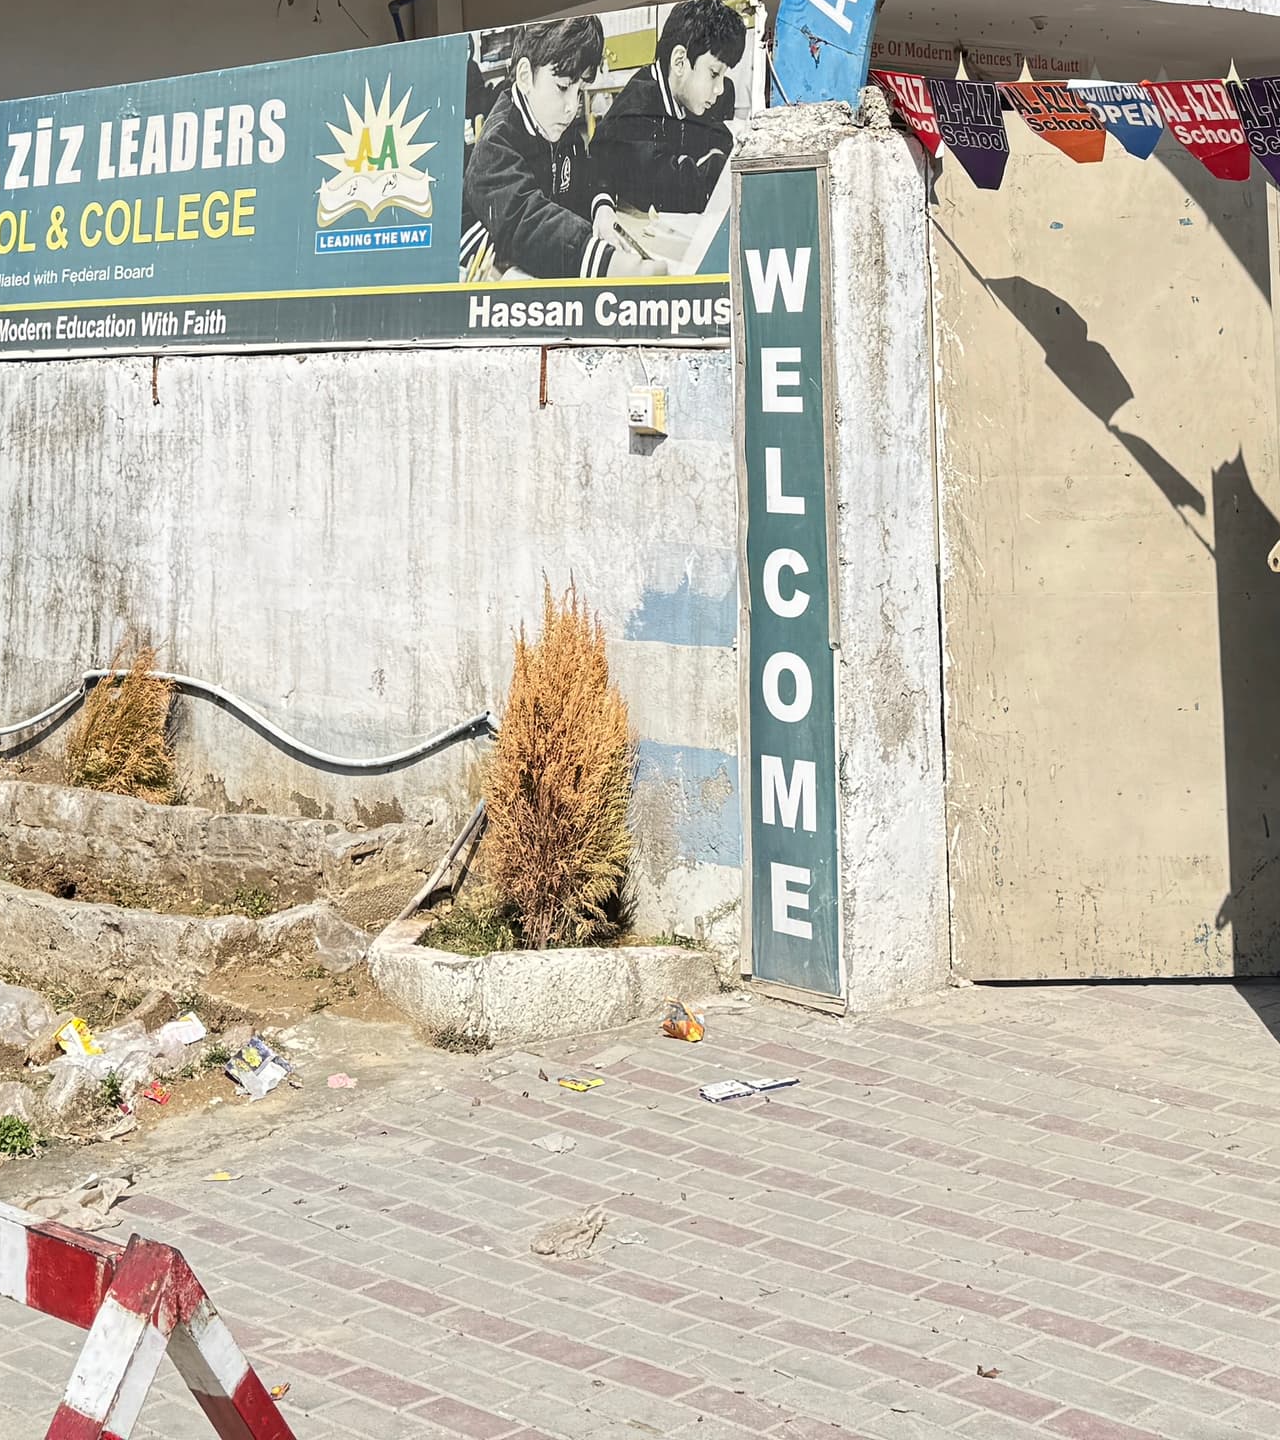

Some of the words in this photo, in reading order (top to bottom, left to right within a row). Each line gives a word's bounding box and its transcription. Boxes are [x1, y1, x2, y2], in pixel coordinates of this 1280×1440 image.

[904, 42, 952, 61] Modern
[963, 48, 1012, 67] ciences
[930, 79, 1004, 128] AL-AZIZ
[1002, 85, 1091, 115] AL-AZIZ
[1154, 83, 1239, 123] AL-AZIZ
[98, 98, 287, 180] LEADERS
[940, 124, 1009, 153] School
[1025, 116, 1104, 133] School
[45, 205, 69, 250] &
[79, 187, 257, 248] COLLEGE
[320, 233, 371, 249] LEADING
[373, 231, 398, 245] THE
[400, 229, 427, 243] WAY
[33, 270, 58, 286] with
[61, 266, 111, 284] Federal
[114, 263, 154, 280] Board
[55, 313, 136, 339] Education
[140, 310, 178, 336] With
[182, 309, 227, 336] Faith
[469, 293, 584, 328] Hassan
[594, 291, 730, 334] Campus
[745, 248, 817, 940] WELCOME
